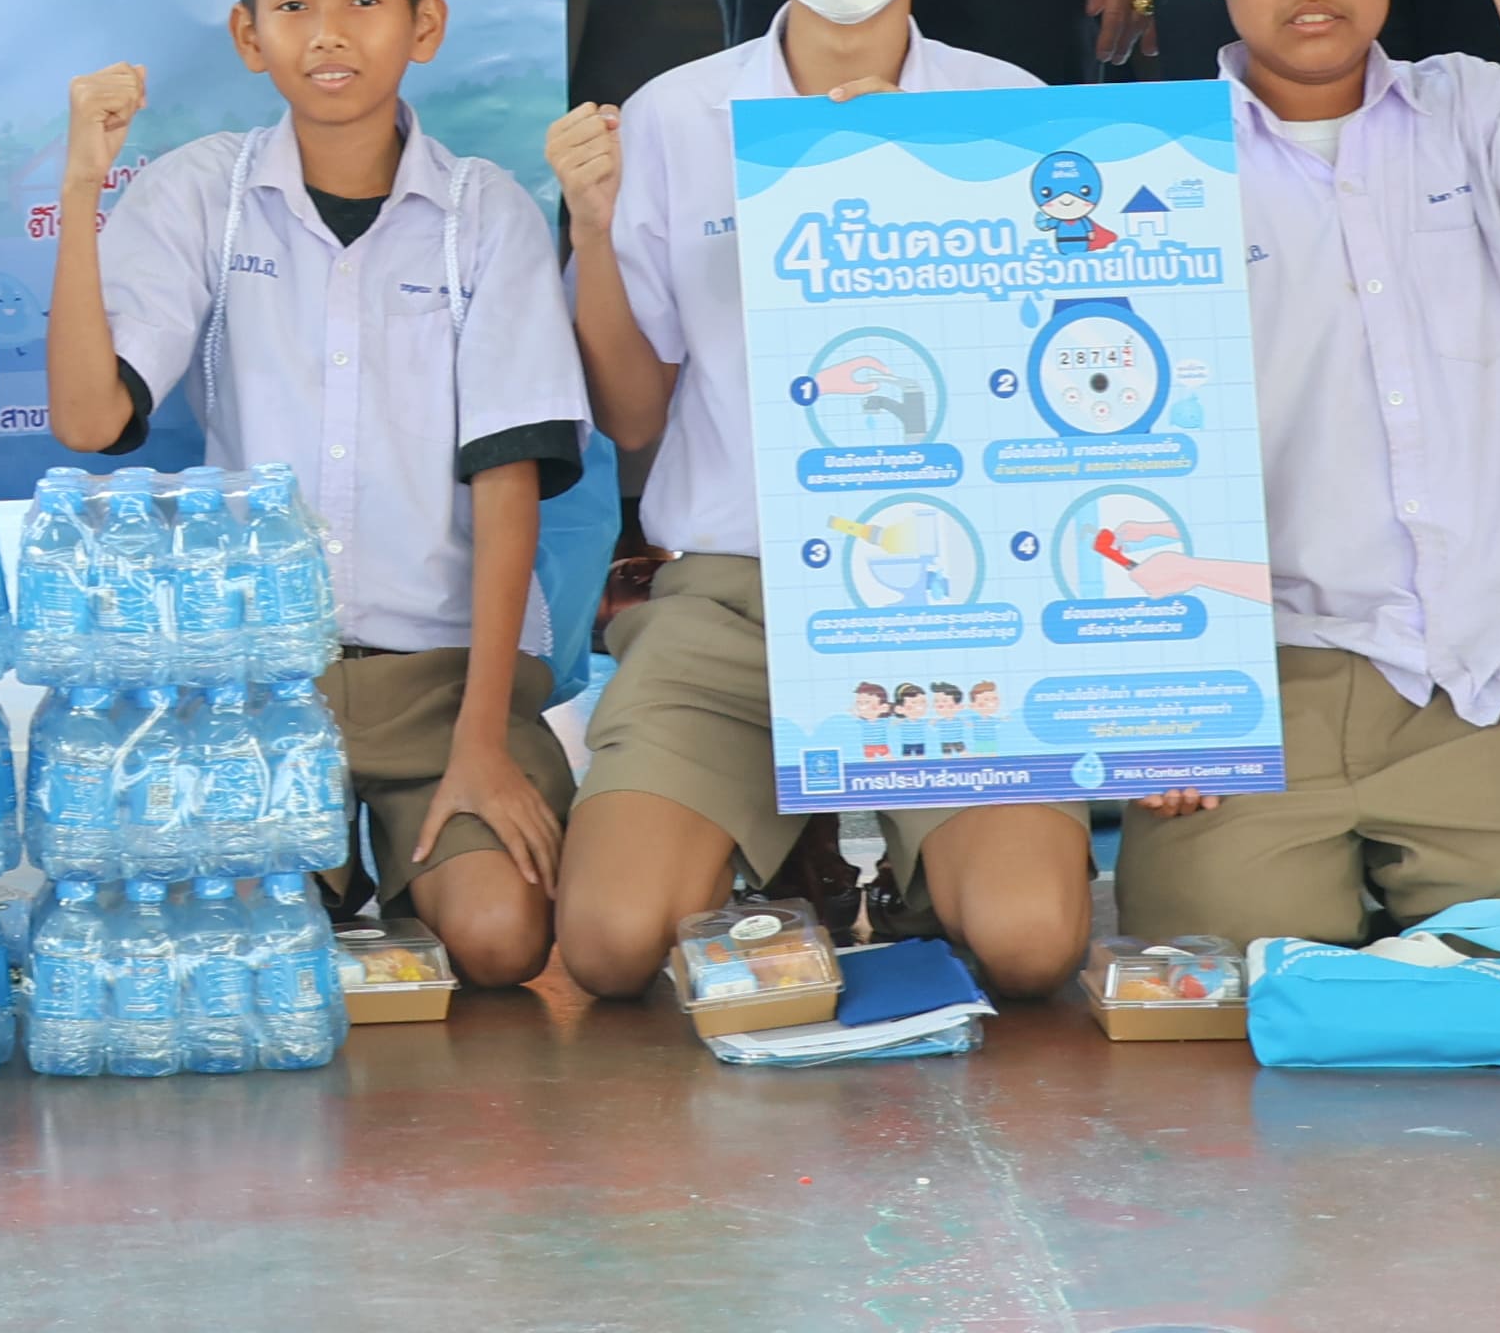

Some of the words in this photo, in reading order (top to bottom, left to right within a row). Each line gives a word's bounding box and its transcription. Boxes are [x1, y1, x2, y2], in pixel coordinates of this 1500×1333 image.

[834, 208, 1012, 261] ขั้นตอน
[783, 221, 829, 293] 4
[996, 374, 1015, 393] 2
[808, 543, 825, 561] 3
[1017, 536, 1036, 554] 4
[851, 768, 1031, 792] การประปาส่วนภูมิภาค
[1114, 769, 1143, 780] PWA
[1145, 767, 1189, 779] Contact
[1192, 766, 1232, 777] Center
